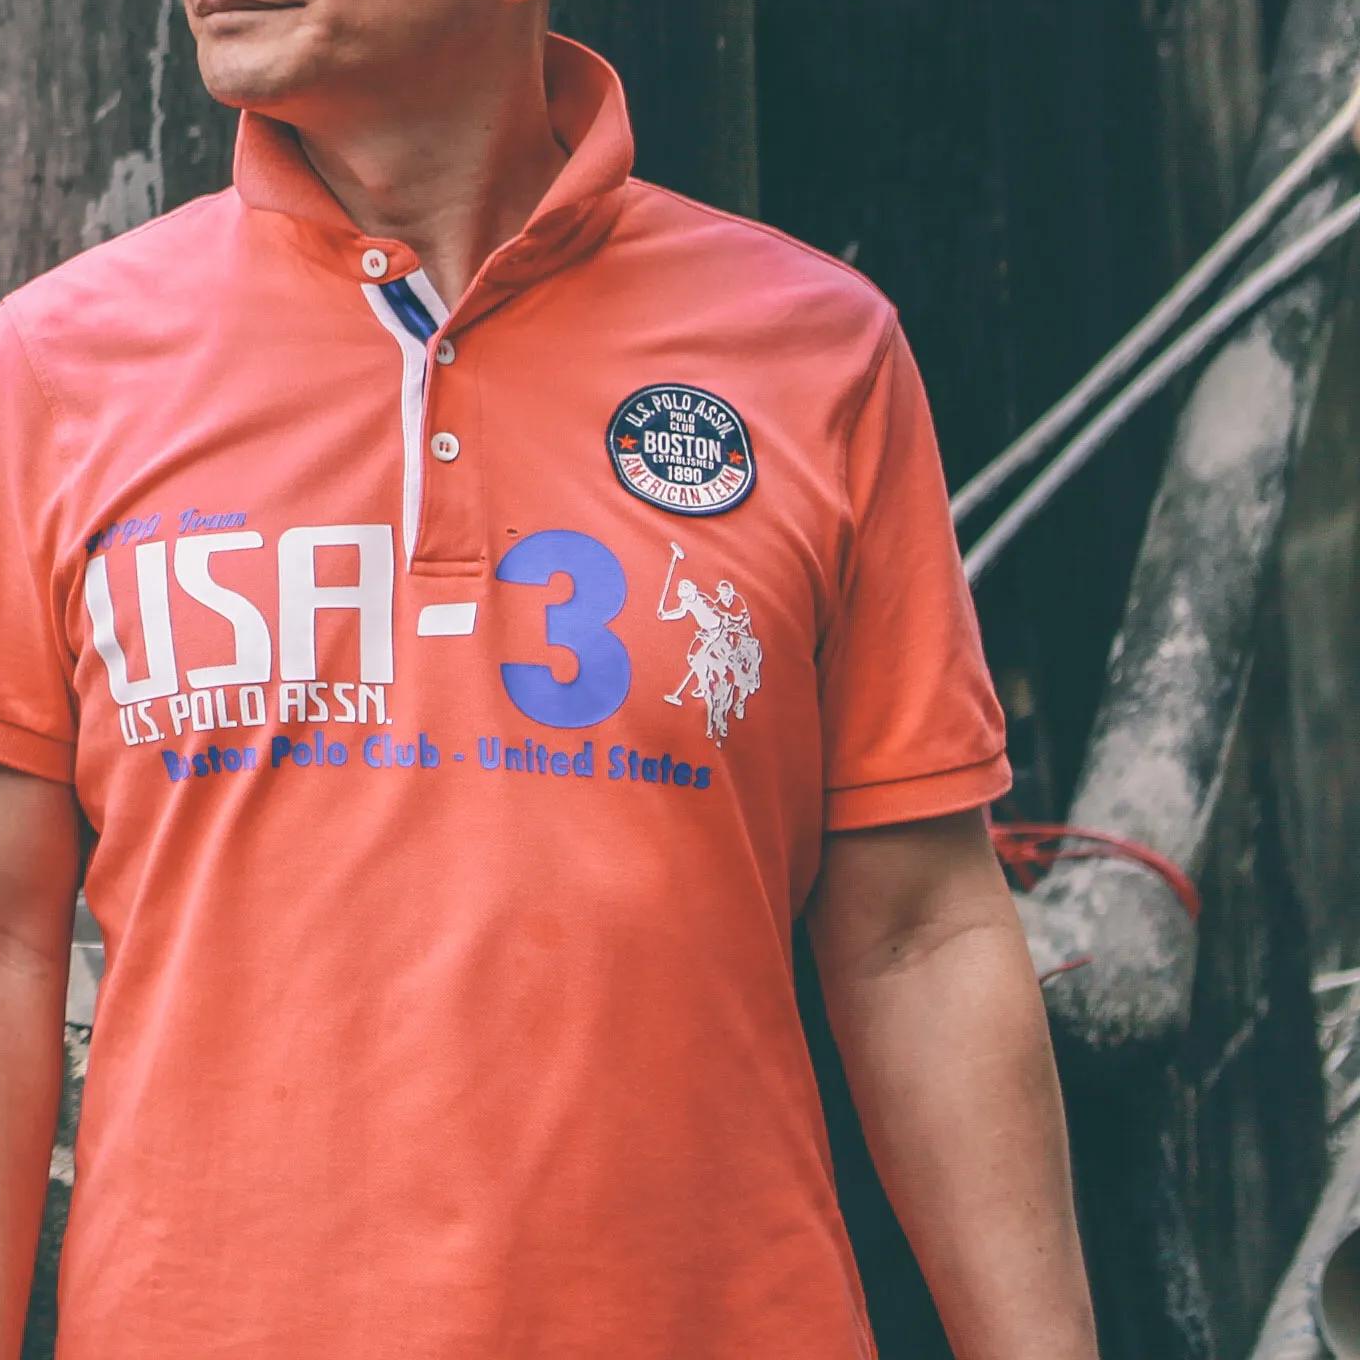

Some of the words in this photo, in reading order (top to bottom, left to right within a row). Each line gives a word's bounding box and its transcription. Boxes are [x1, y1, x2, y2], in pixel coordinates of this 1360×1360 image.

[652, 393, 691, 412] POLO
[670, 411, 696, 423] POLO
[670, 422, 696, 435] CLUB
[644, 430, 722, 463] BOSTON
[653, 454, 715, 470] ESTABLISHED
[621, 455, 702, 506] AMERICAN
[704, 468, 742, 504] TEAM
[667, 465, 702, 484] 1890
[119, 698, 166, 746] U.S.
[168, 686, 266, 736] POLO
[280, 682, 393, 725] ASSN.
[271, 730, 347, 768] Polo
[363, 732, 440, 769] Club
[478, 736, 594, 778] United
[608, 745, 712, 789] States
